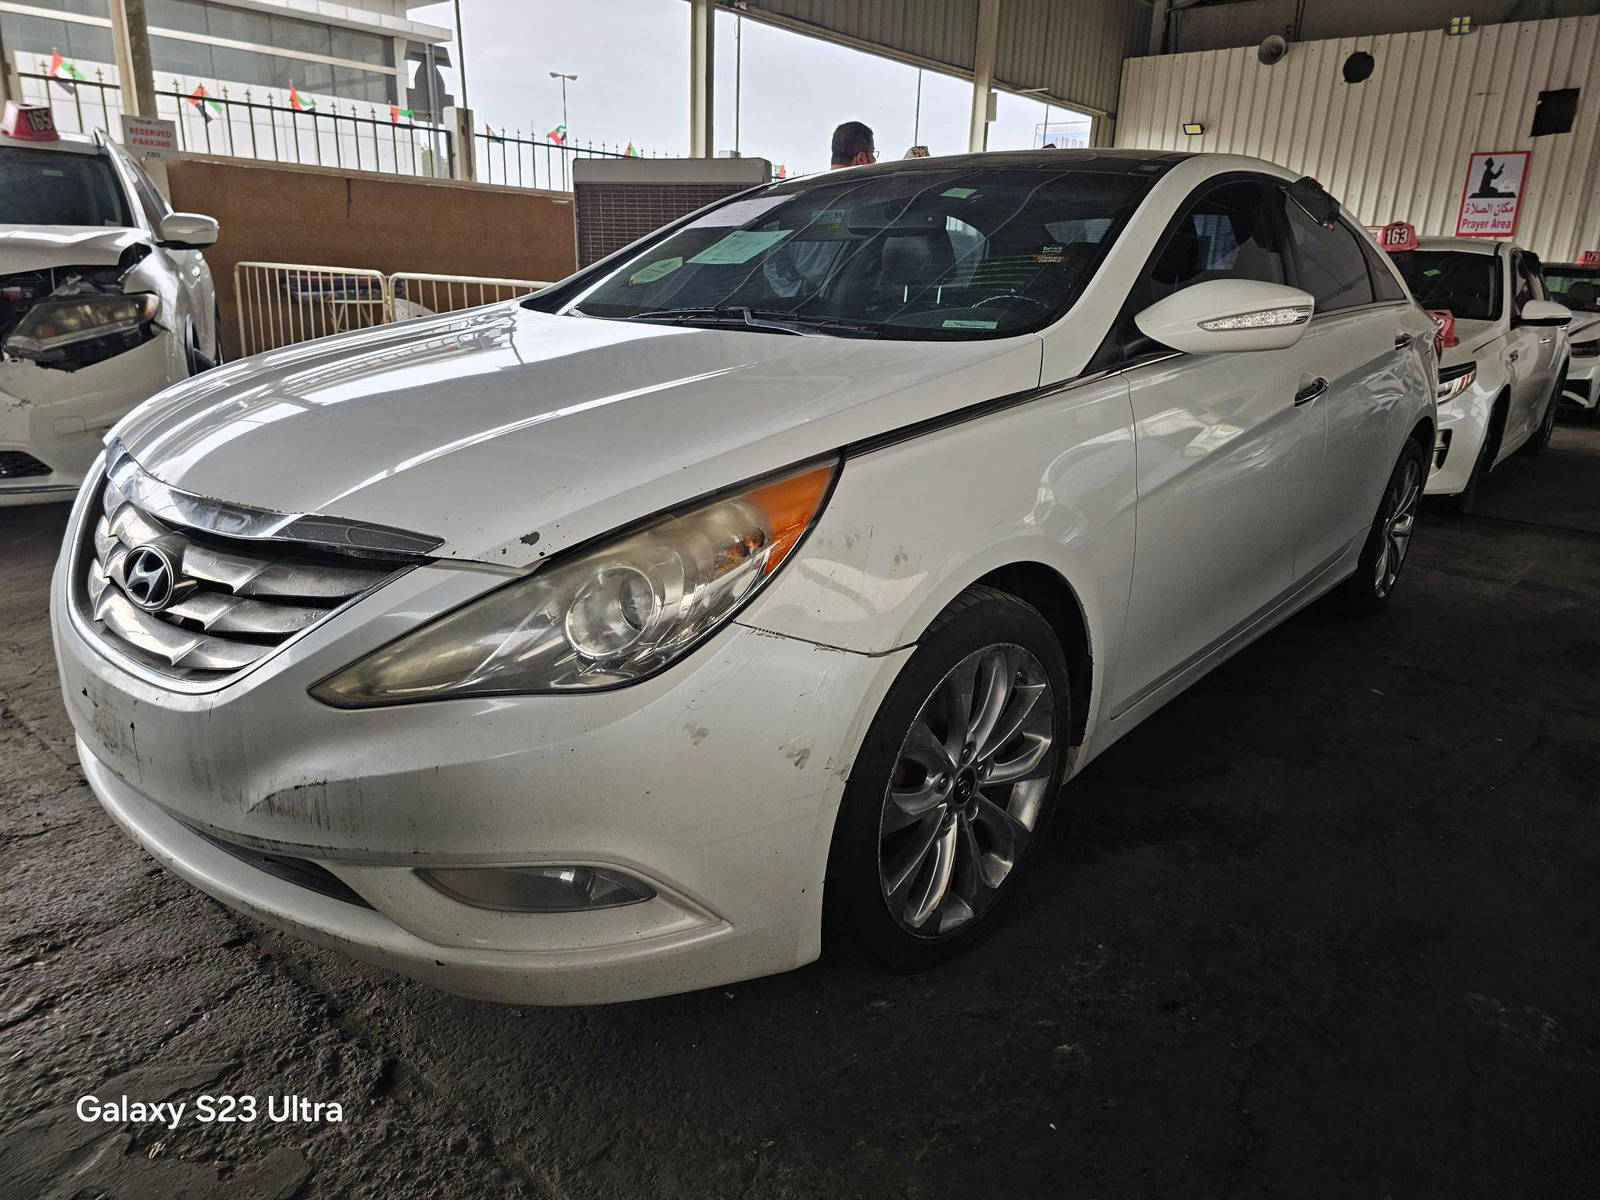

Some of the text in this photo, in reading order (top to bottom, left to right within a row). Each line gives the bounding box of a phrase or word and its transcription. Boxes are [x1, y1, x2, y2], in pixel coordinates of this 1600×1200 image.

[27, 110, 52, 132] 165
[129, 127, 172, 138] RESERVED
[132, 138, 171, 148] PARKING
[1464, 201, 1514, 216] مكان الصلاة
[1461, 218, 1512, 231] Prayer Area
[1386, 228, 1408, 245] 163
